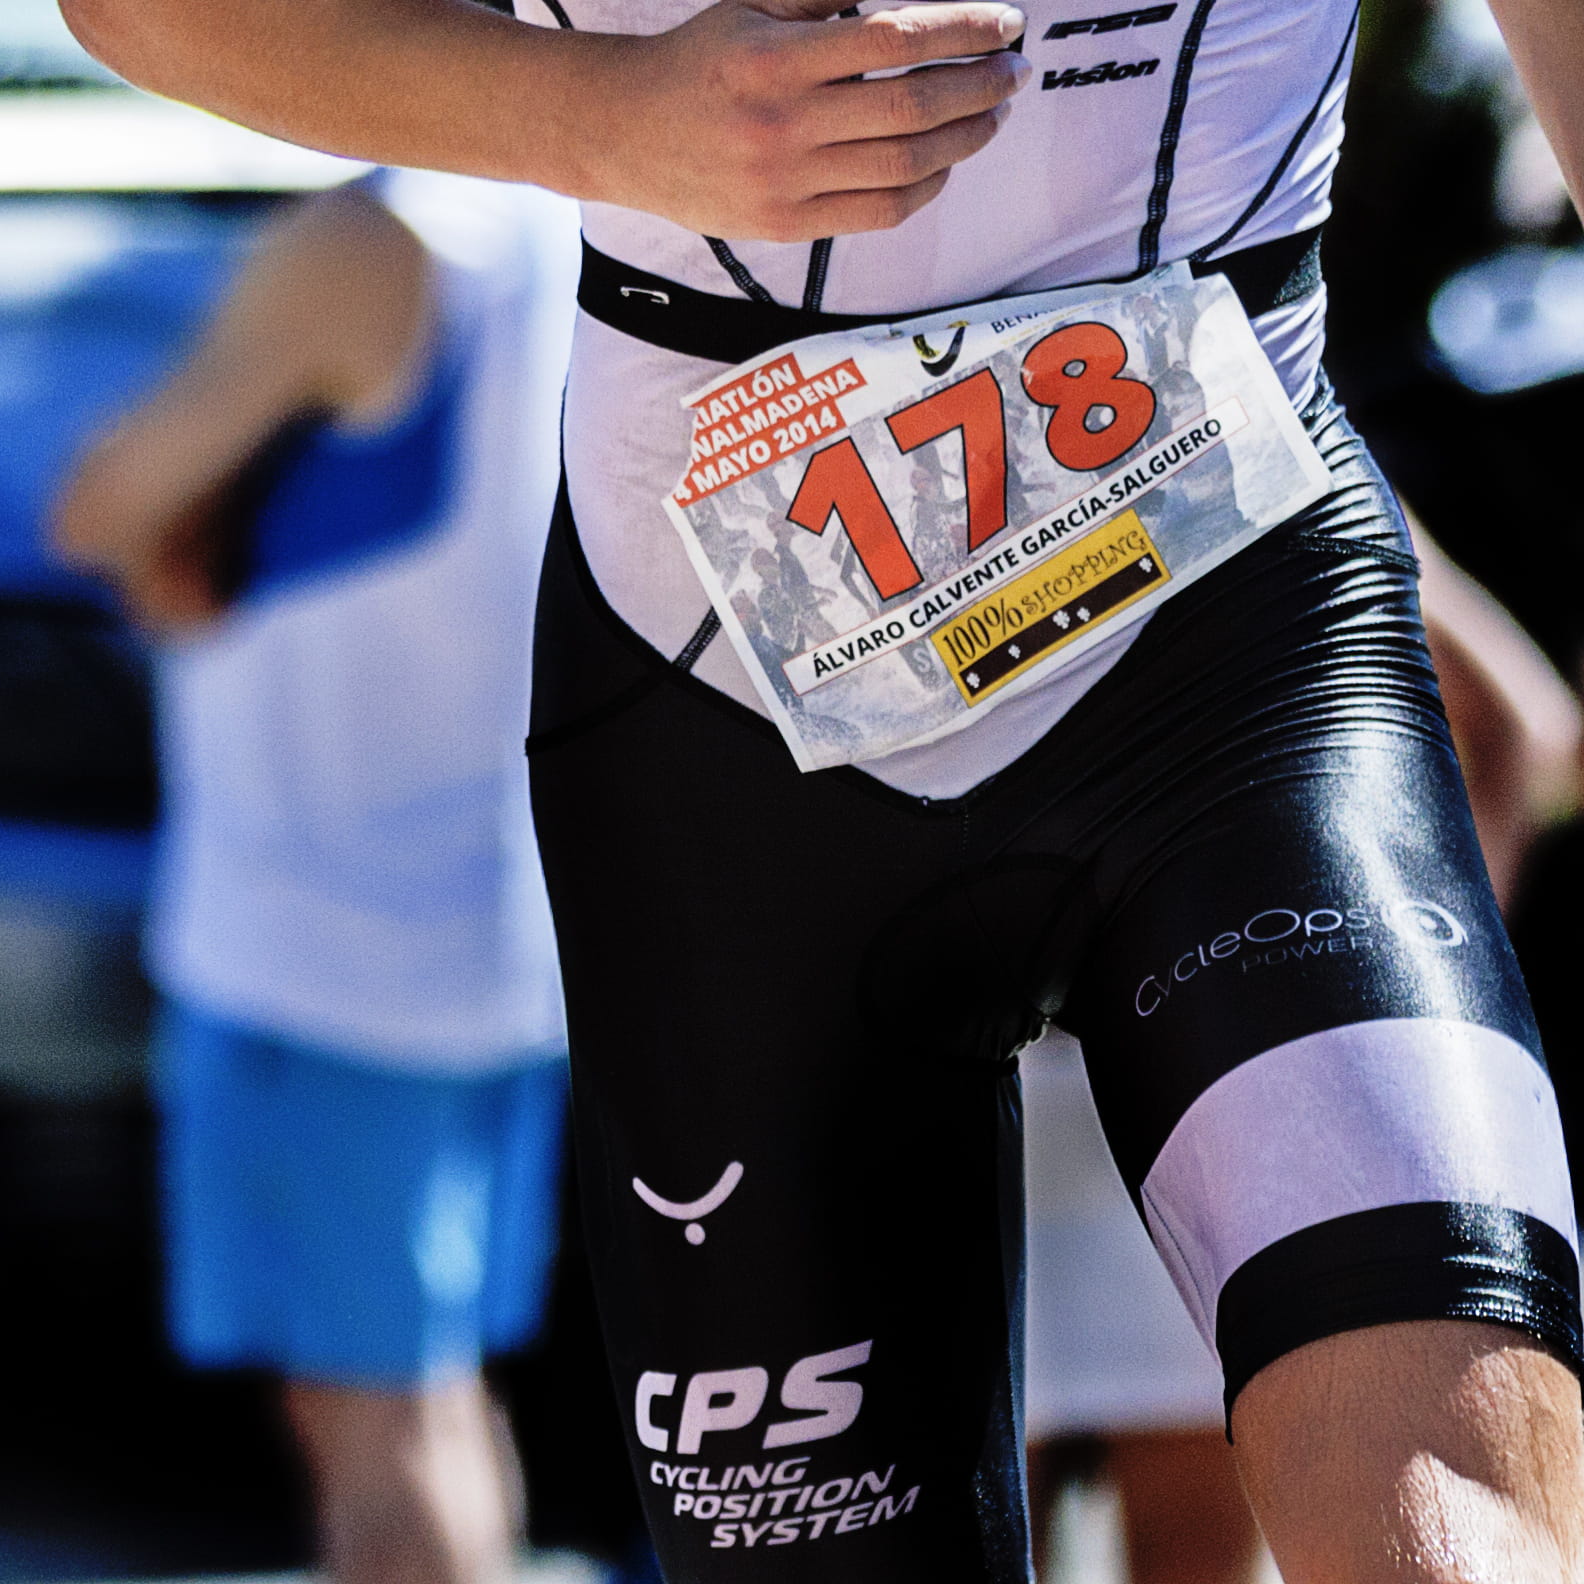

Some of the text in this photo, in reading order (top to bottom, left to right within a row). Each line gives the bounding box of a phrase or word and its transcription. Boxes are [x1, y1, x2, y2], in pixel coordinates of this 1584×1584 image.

[1042, 58, 1160, 90] Vision
[690, 440, 771, 494] MAYO
[773, 406, 837, 454] 2014
[786, 320, 1156, 602] 178
[813, 419, 1221, 678] ÁLVARO CALVENTE GARCÍA-SALGUERO
[942, 529, 1148, 667] 100% SHOPPING
[1135, 908, 1371, 1016] CycleOps
[1242, 935, 1373, 973] POWER
[635, 1339, 873, 1454] CPS
[650, 1456, 811, 1490] CYCLING
[673, 1464, 895, 1520] POSITION
[710, 1485, 920, 1548] SYSTEM
